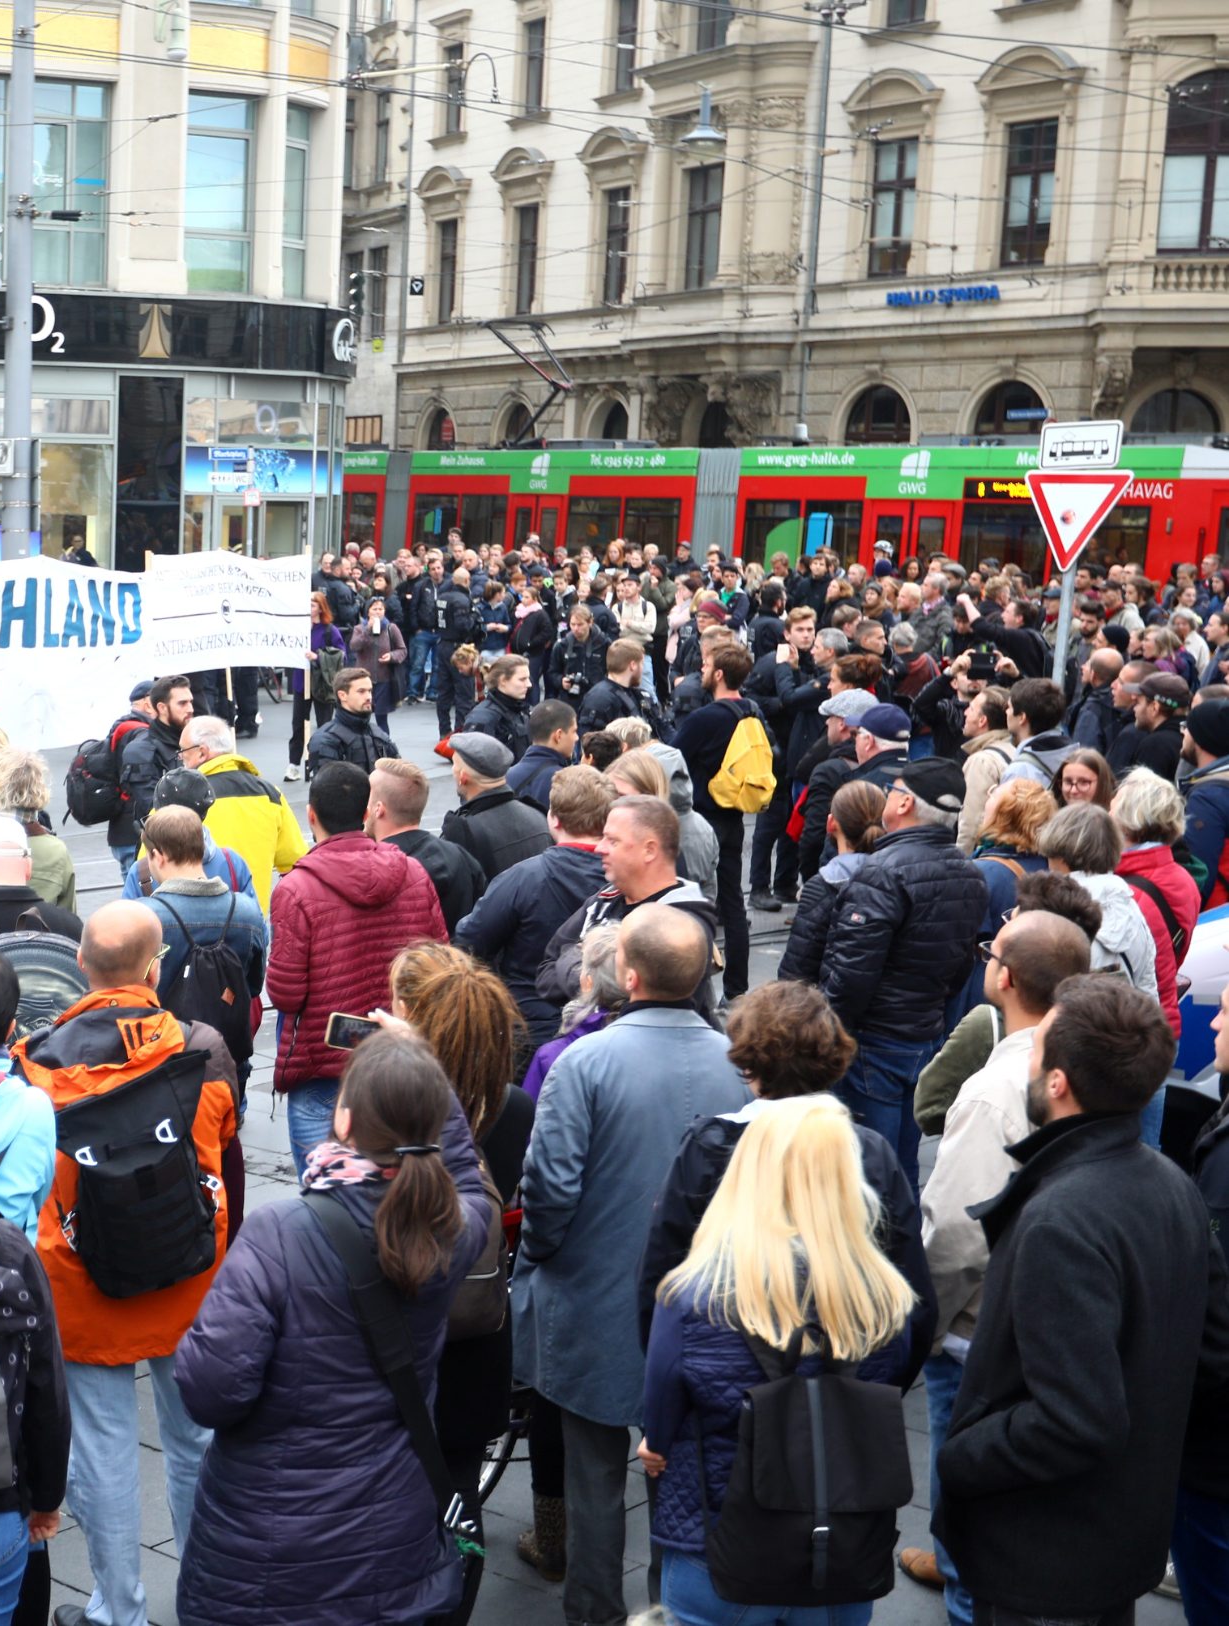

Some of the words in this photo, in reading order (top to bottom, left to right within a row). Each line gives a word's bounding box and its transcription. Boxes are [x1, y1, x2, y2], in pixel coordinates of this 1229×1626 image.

[440, 456, 455, 465] Mein
[590, 454, 602, 466] Tel.
[604, 455, 621, 467] 0345
[758, 452, 855, 467] www.gwg-halle.de
[529, 479, 548, 489] GWG
[898, 482, 927, 495] GWG
[1123, 482, 1174, 500] HAVAG
